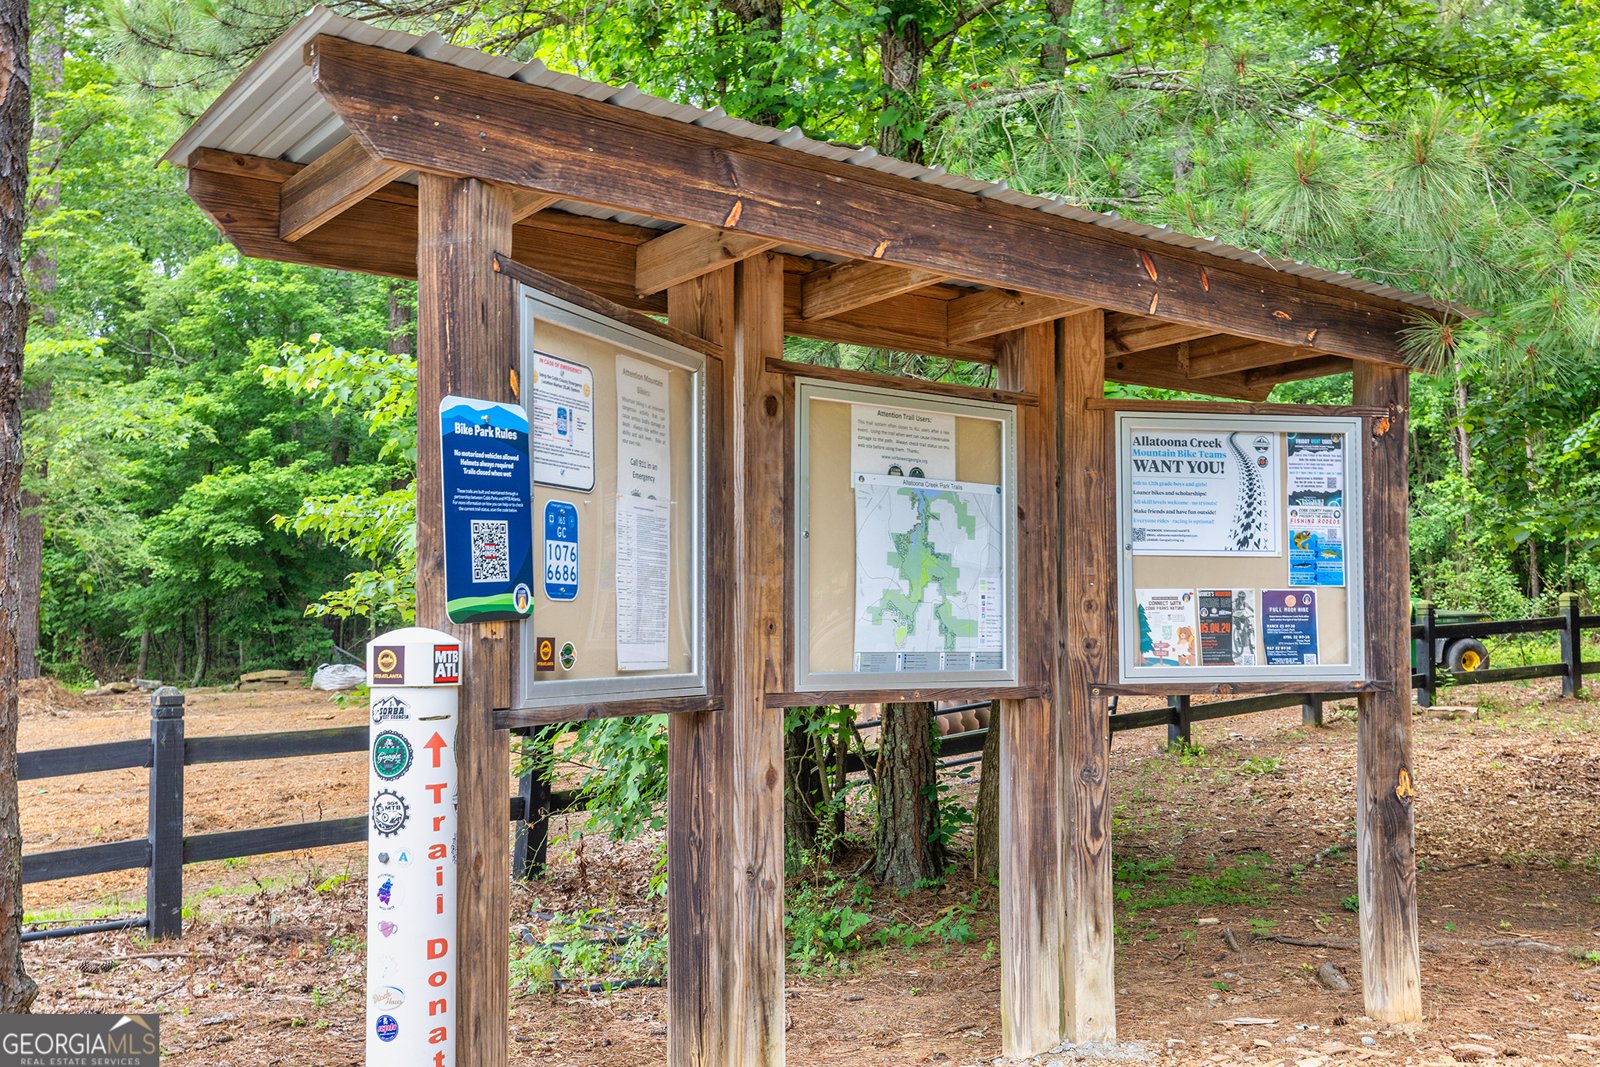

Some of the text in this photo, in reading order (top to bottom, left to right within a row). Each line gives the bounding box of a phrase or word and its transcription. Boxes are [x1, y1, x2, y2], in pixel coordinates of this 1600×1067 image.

[877, 410, 902, 419] Attention
[454, 422, 517, 440] Bike Park Rules
[1132, 436, 1222, 448] Allatoona Creek
[1132, 448, 1226, 459] Mountain Bike Teams
[460, 458, 514, 470] Helmets always required
[630, 458, 638, 467] Call
[1133, 459, 1225, 474] WANT YOU!
[632, 470, 655, 484] Emergency
[557, 527, 567, 538] GC
[548, 544, 577, 562] 1076
[547, 564, 577, 581] 6686
[1200, 622, 1230, 634] 05.04.24
[435, 650, 458, 663] MTB
[436, 663, 458, 677] ATL
[378, 752, 401, 764] Georgia
[399, 852, 408, 862] A
